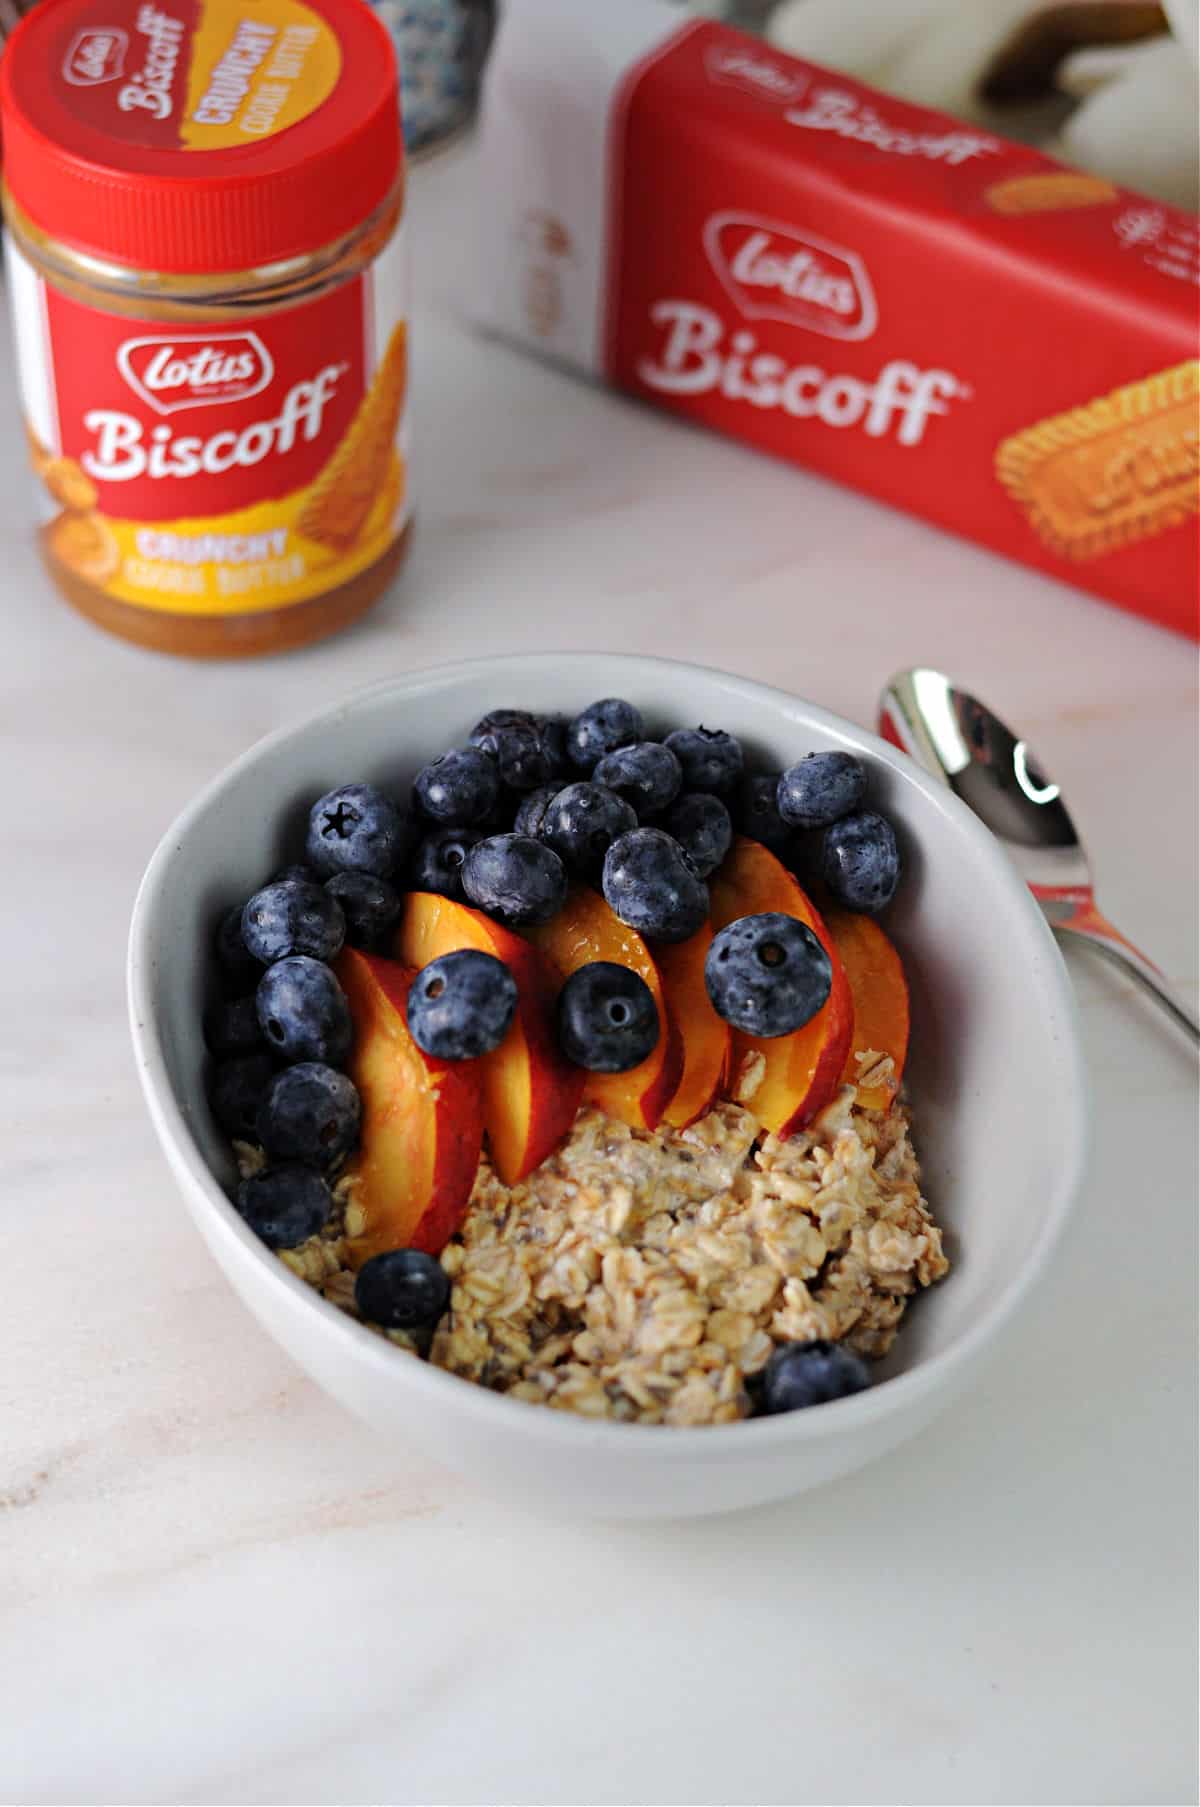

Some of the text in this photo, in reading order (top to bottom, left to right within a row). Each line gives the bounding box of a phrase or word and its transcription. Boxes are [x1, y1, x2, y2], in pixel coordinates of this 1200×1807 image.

[117, 3, 185, 120] Biscoff
[192, 19, 278, 125] CRUNCHY
[731, 232, 855, 314] Lotus
[143, 344, 257, 389] Lotus
[637, 299, 959, 446] Biscoff
[81, 365, 340, 480] Biscoff
[135, 529, 288, 562] CRUNCHY
